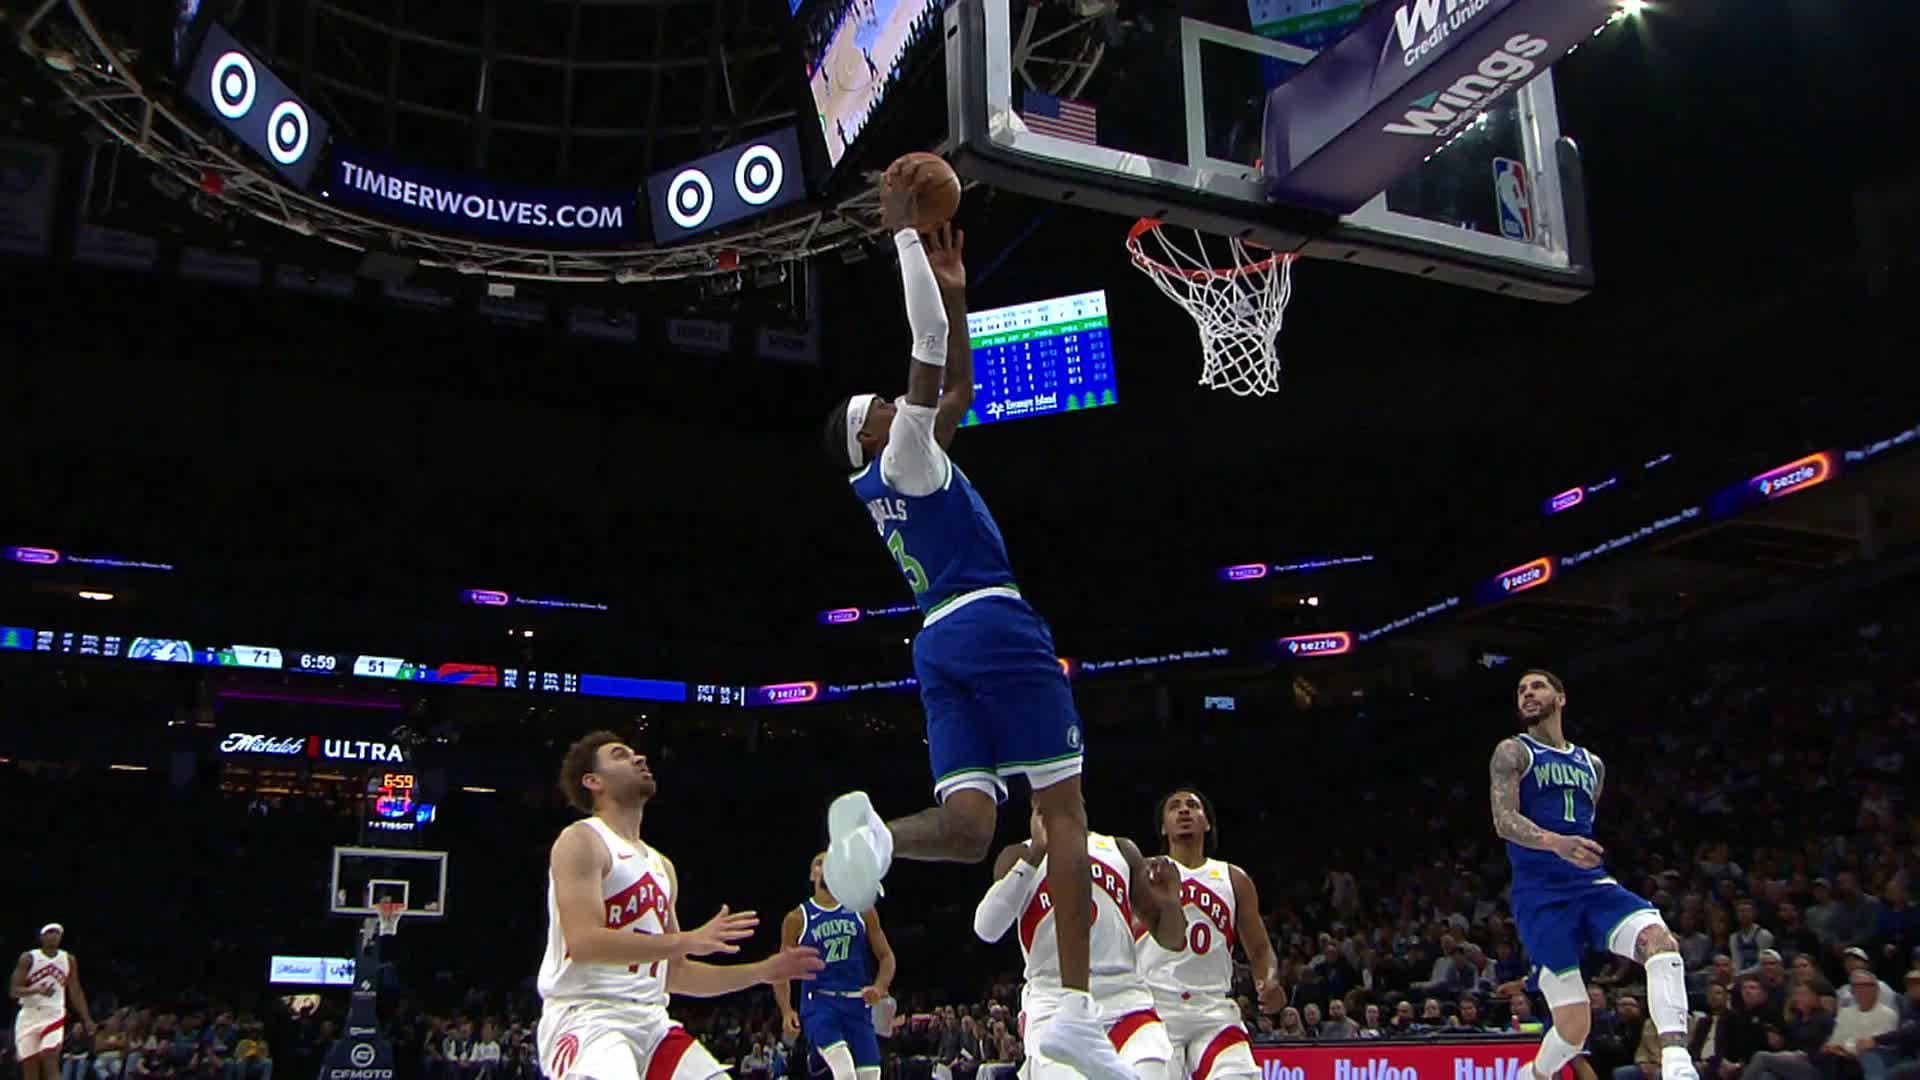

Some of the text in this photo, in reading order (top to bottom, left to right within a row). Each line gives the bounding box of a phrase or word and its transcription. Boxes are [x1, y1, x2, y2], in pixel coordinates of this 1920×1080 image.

[1403, 21, 1450, 67] Credit
[1382, 33, 1548, 135] Wings
[341, 160, 623, 229] TIMBERWOLVES.COM
[1773, 465, 1815, 490] sezzle
[1512, 567, 1541, 587] sezzle
[253, 650, 271, 664] 71
[1301, 639, 1337, 650] sezzle
[300, 654, 337, 670] 6:59
[367, 660, 385, 673] 51
[777, 688, 807, 699] sezzle
[220, 733, 404, 762] Michelob ULTRA
[1533, 762, 1595, 800] WOLVE
[1563, 789, 1576, 822] 1
[811, 919, 857, 942] WOLVES
[1184, 921, 1212, 955] 0
[824, 935, 851, 962] 27
